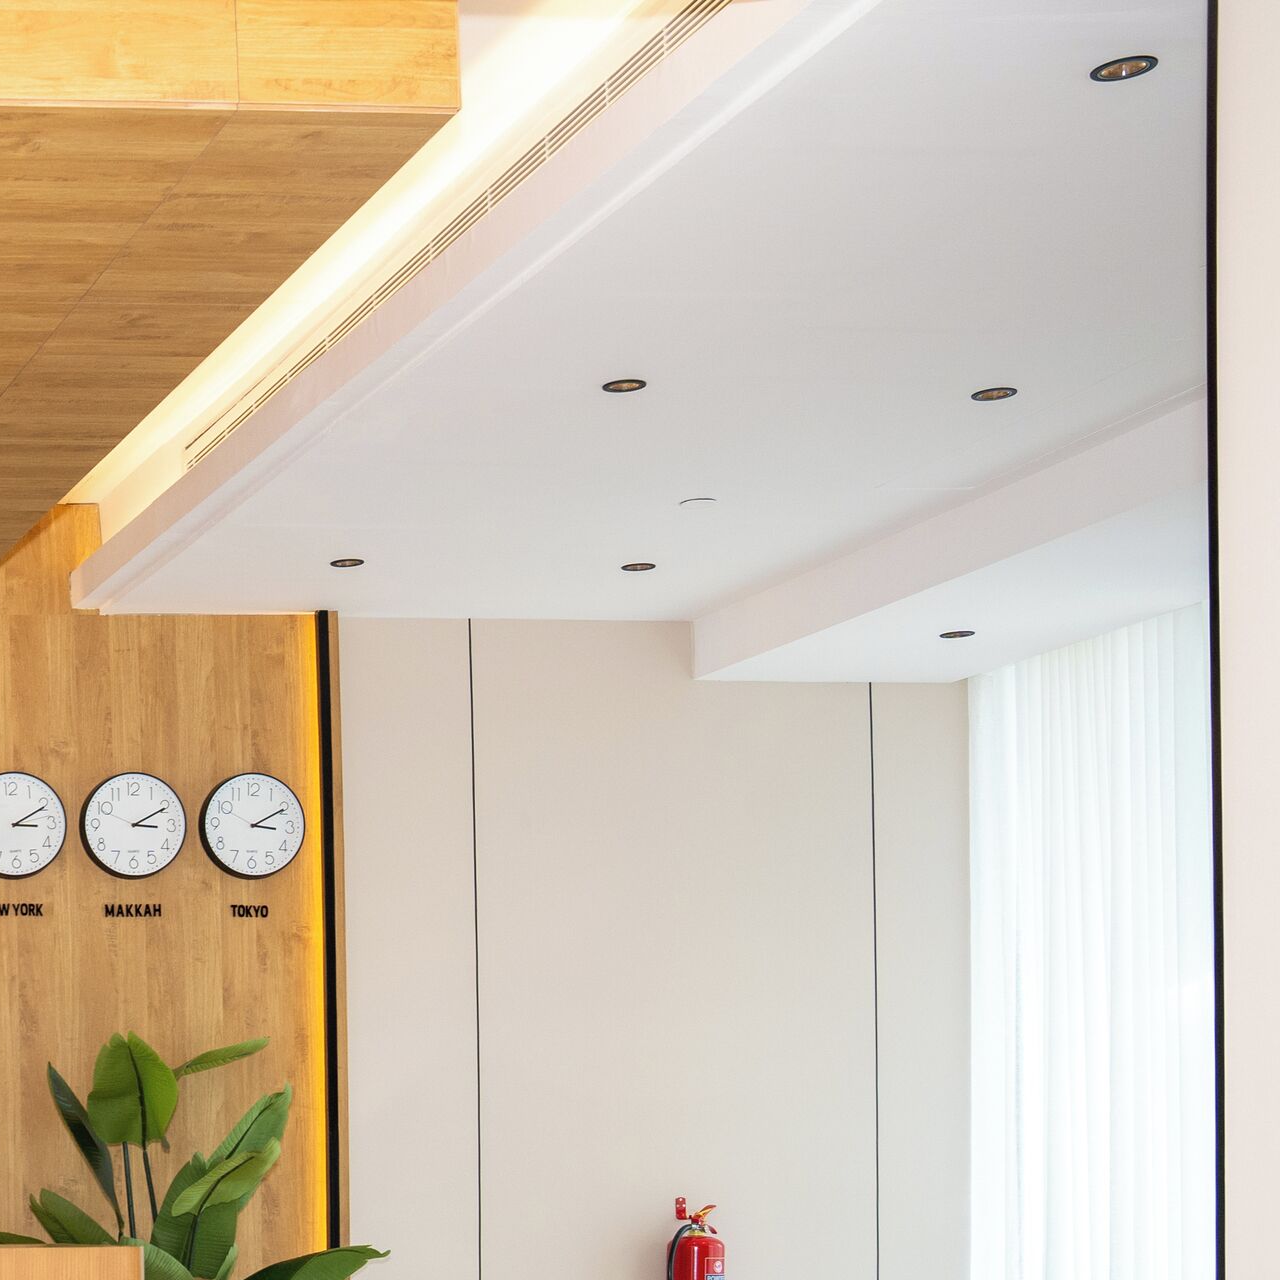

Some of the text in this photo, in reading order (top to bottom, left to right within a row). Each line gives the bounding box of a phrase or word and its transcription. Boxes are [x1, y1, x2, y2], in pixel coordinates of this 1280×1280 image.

[4, 781, 18, 796] 12
[111, 788, 120, 801] 11
[127, 782, 140, 796] 12
[232, 787, 240, 801] 11
[247, 782, 260, 797] 12
[39, 797, 48, 811] 2
[98, 801, 113, 815] 10
[159, 800, 170, 813] 2
[218, 800, 233, 814] 10
[279, 801, 289, 815] 2
[47, 816, 56, 830] 3
[91, 818, 100, 832] 9
[166, 819, 176, 832] 3
[211, 817, 220, 830] 9
[285, 820, 294, 834] 3
[42, 835, 52, 848] 4
[97, 837, 105, 851] 8
[161, 838, 170, 851] 4
[216, 836, 225, 850] 8
[278, 840, 288, 852] 4
[12, 855, 22, 869] 6
[29, 849, 39, 863] 5
[111, 850, 120, 864] 7
[129, 856, 139, 869] 6
[147, 851, 157, 864] 5
[230, 850, 239, 863] 7
[247, 856, 257, 869] 6
[265, 851, 274, 865] 5
[12, 903, 43, 917] YORK
[105, 904, 161, 917] MAKKAH
[231, 905, 268, 917] TOKYO
